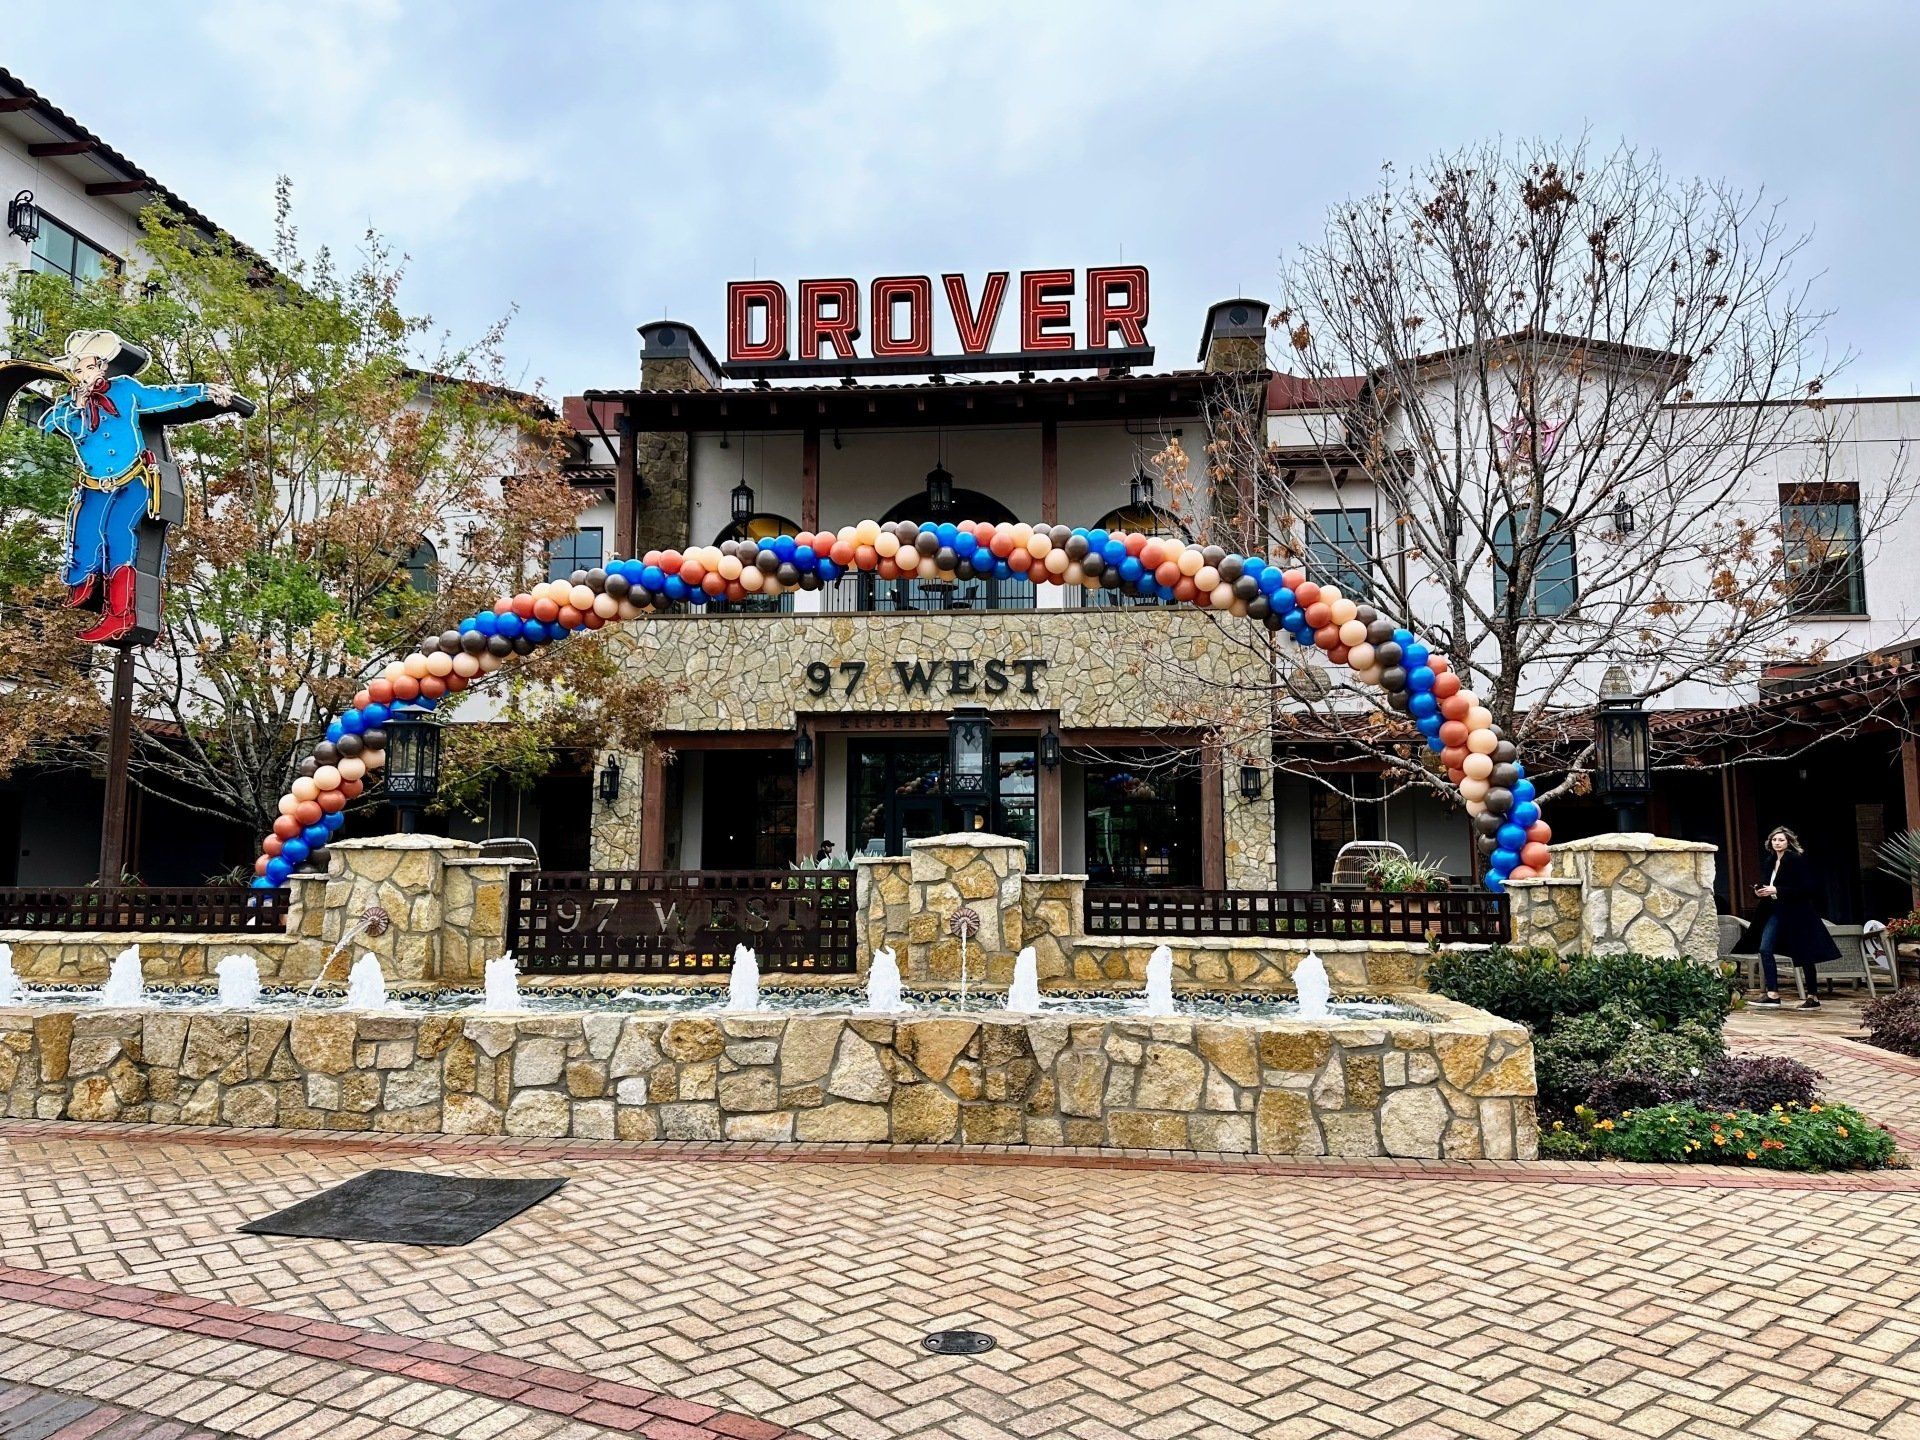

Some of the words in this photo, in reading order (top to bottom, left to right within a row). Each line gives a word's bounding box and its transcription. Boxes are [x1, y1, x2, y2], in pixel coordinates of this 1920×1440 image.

[727, 266, 1150, 362] DROVER
[806, 661, 866, 696] 97
[892, 659, 1048, 695] WEST
[840, 715, 931, 729] KITCHEN
[557, 897, 619, 933] 97
[648, 896, 813, 933] WEST
[753, 934, 805, 948] BAR
